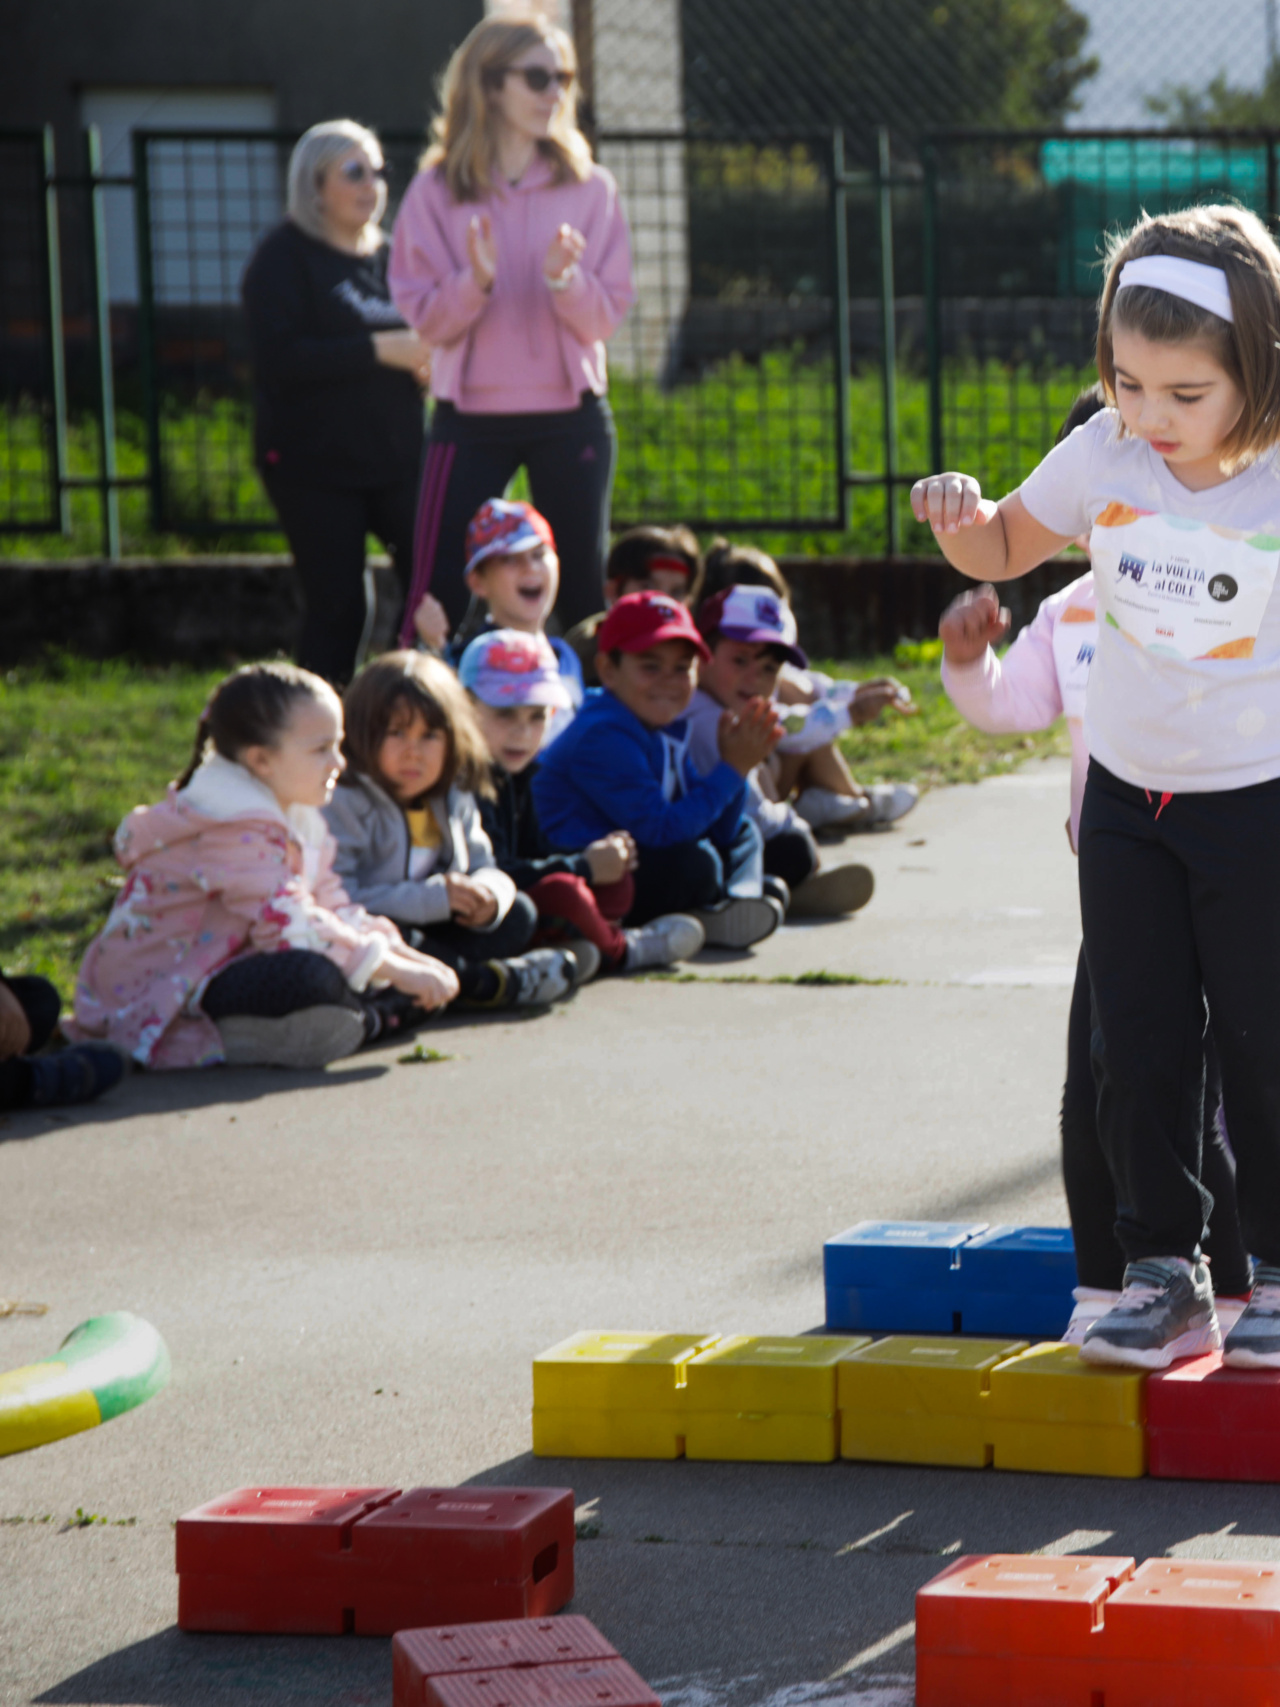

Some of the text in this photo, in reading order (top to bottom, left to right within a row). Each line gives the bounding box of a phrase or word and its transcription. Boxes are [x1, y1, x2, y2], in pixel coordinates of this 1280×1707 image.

[1151, 559, 1162, 574] la
[1166, 562, 1205, 584] VUELTA
[1154, 579, 1166, 591] al
[1168, 580, 1196, 599] COLE
